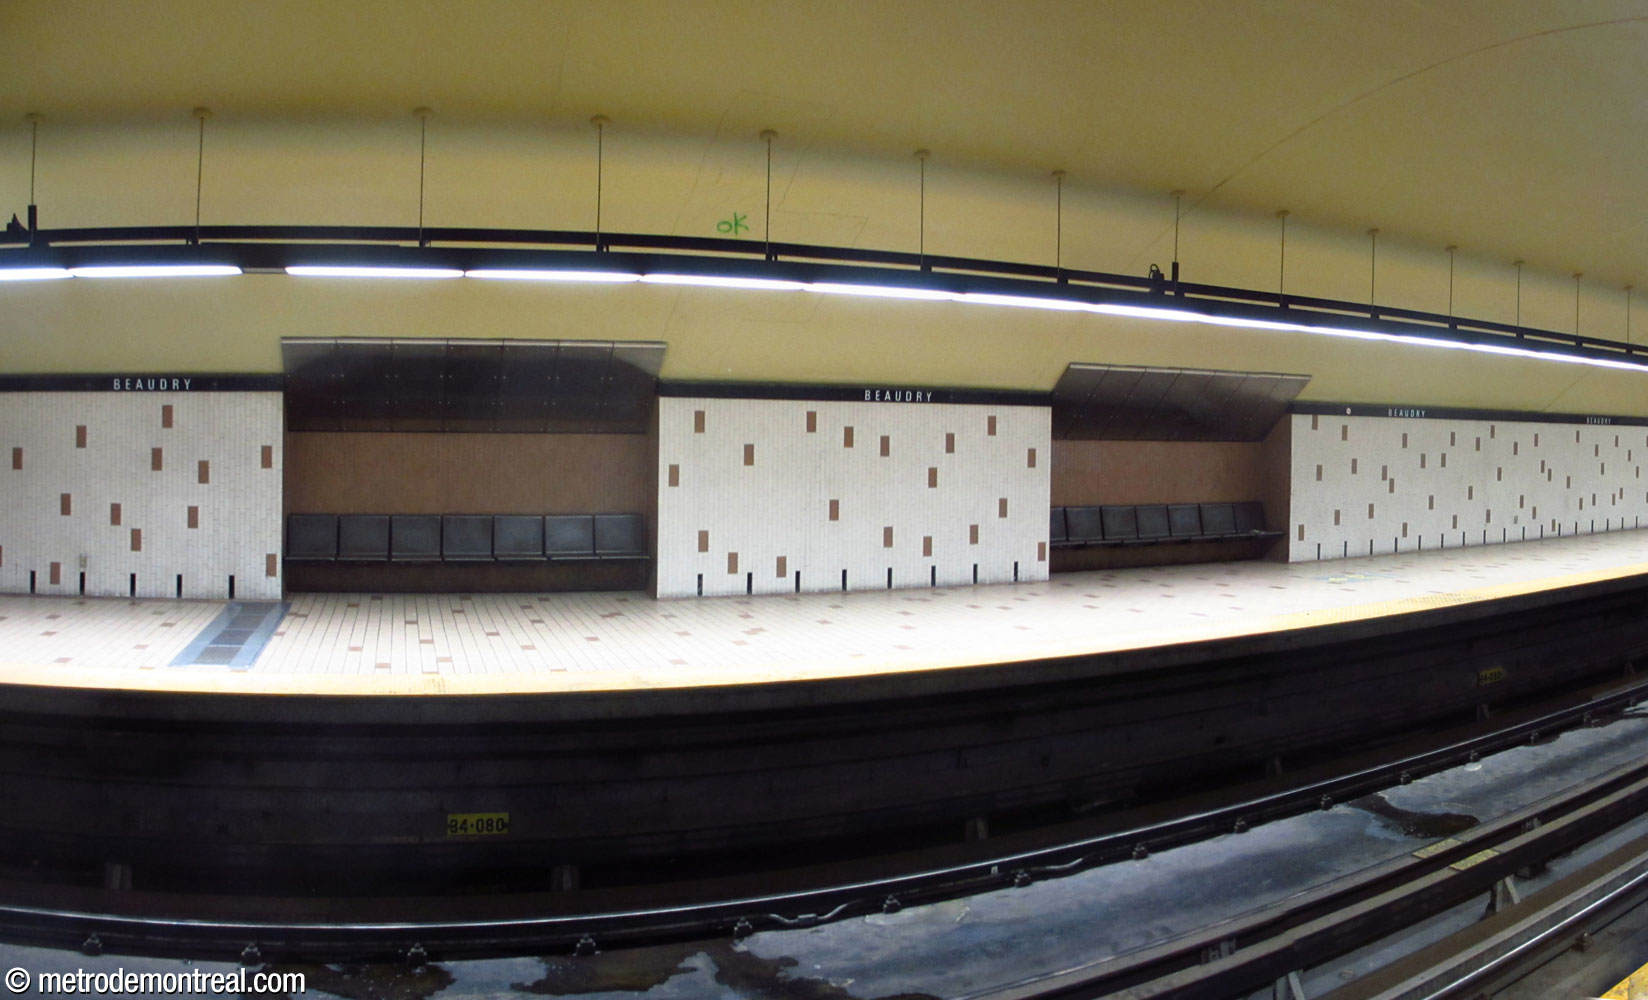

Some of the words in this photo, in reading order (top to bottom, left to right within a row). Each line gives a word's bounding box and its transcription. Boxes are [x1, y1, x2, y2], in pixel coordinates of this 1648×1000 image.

[113, 378, 191, 391] BEAUDRY
[864, 389, 932, 402] BEAUDRY
[1388, 408, 1426, 418] BEAUDRY
